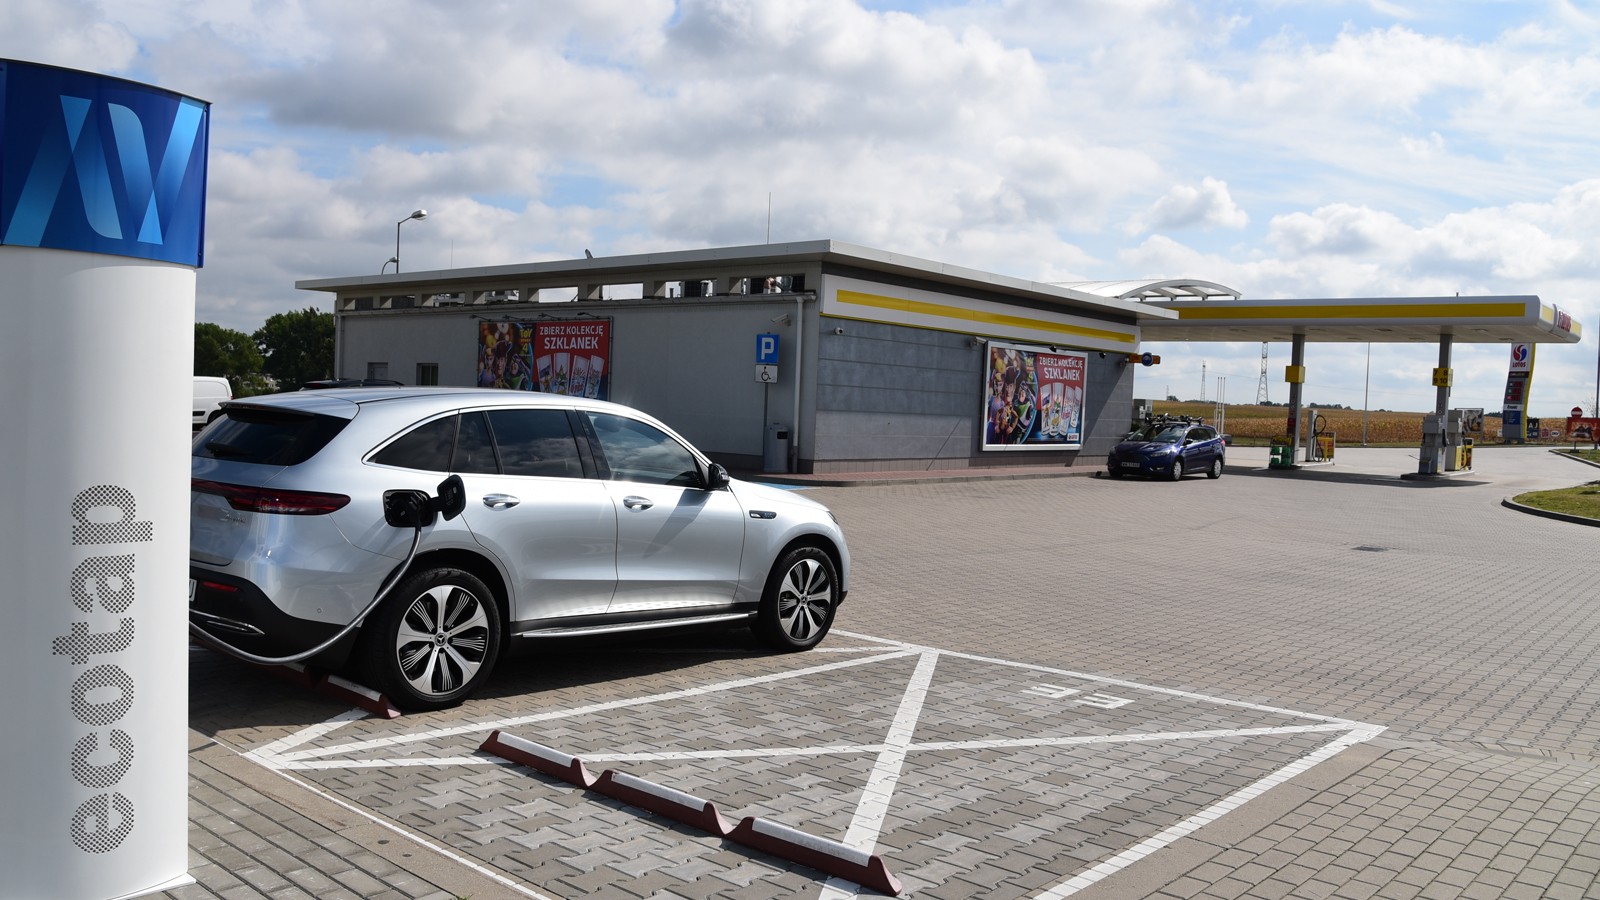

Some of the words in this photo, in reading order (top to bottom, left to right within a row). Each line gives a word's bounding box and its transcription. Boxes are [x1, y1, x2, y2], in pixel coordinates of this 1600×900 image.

[540, 326, 565, 336] ZBIERZ
[566, 325, 604, 337] KOLEKCJĘ
[544, 336, 599, 349] SZKLANEK
[761, 337, 775, 360] P
[1039, 356, 1058, 367] ZBIERZ
[1044, 367, 1080, 381] SZKLANEK
[52, 484, 154, 854] ecotap
